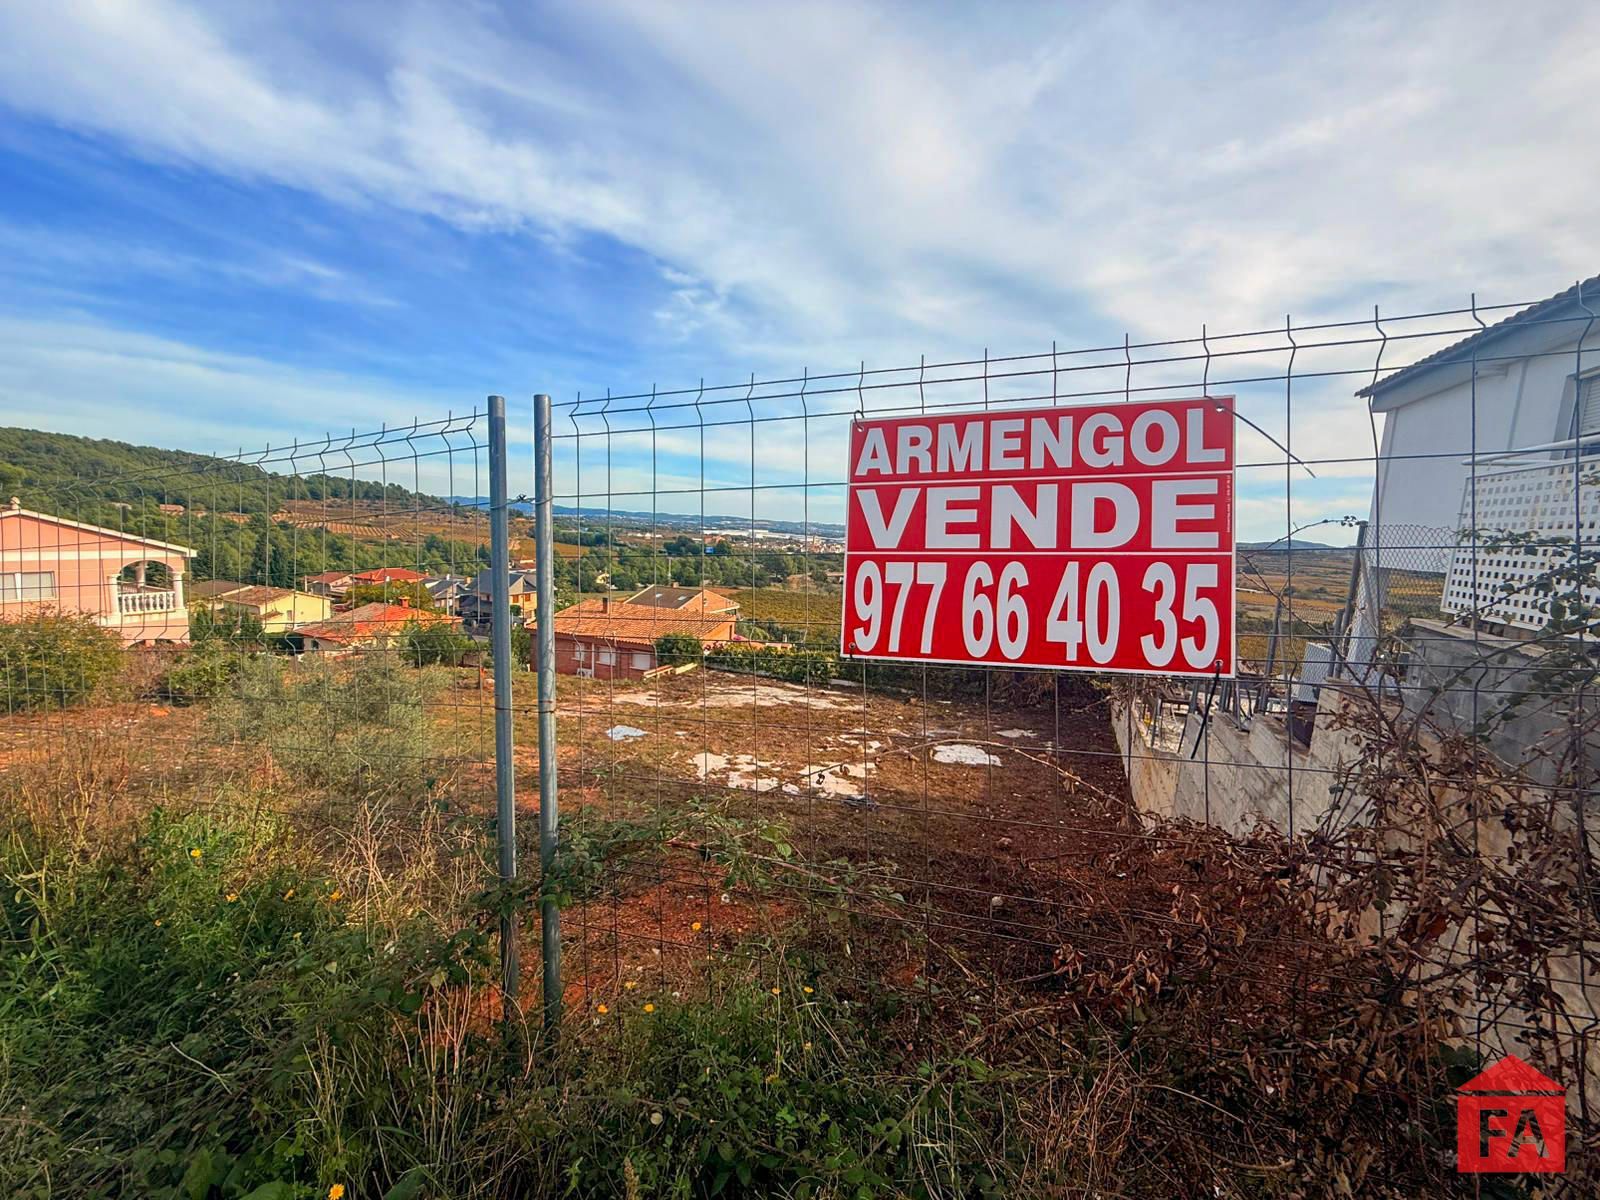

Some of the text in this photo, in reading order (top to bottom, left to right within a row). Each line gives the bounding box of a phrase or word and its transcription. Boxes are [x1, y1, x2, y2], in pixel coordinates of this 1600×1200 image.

[855, 408, 1226, 476] ARMENGOL
[856, 479, 1219, 549] VENDE
[854, 560, 1220, 669] 977 66 40 35
